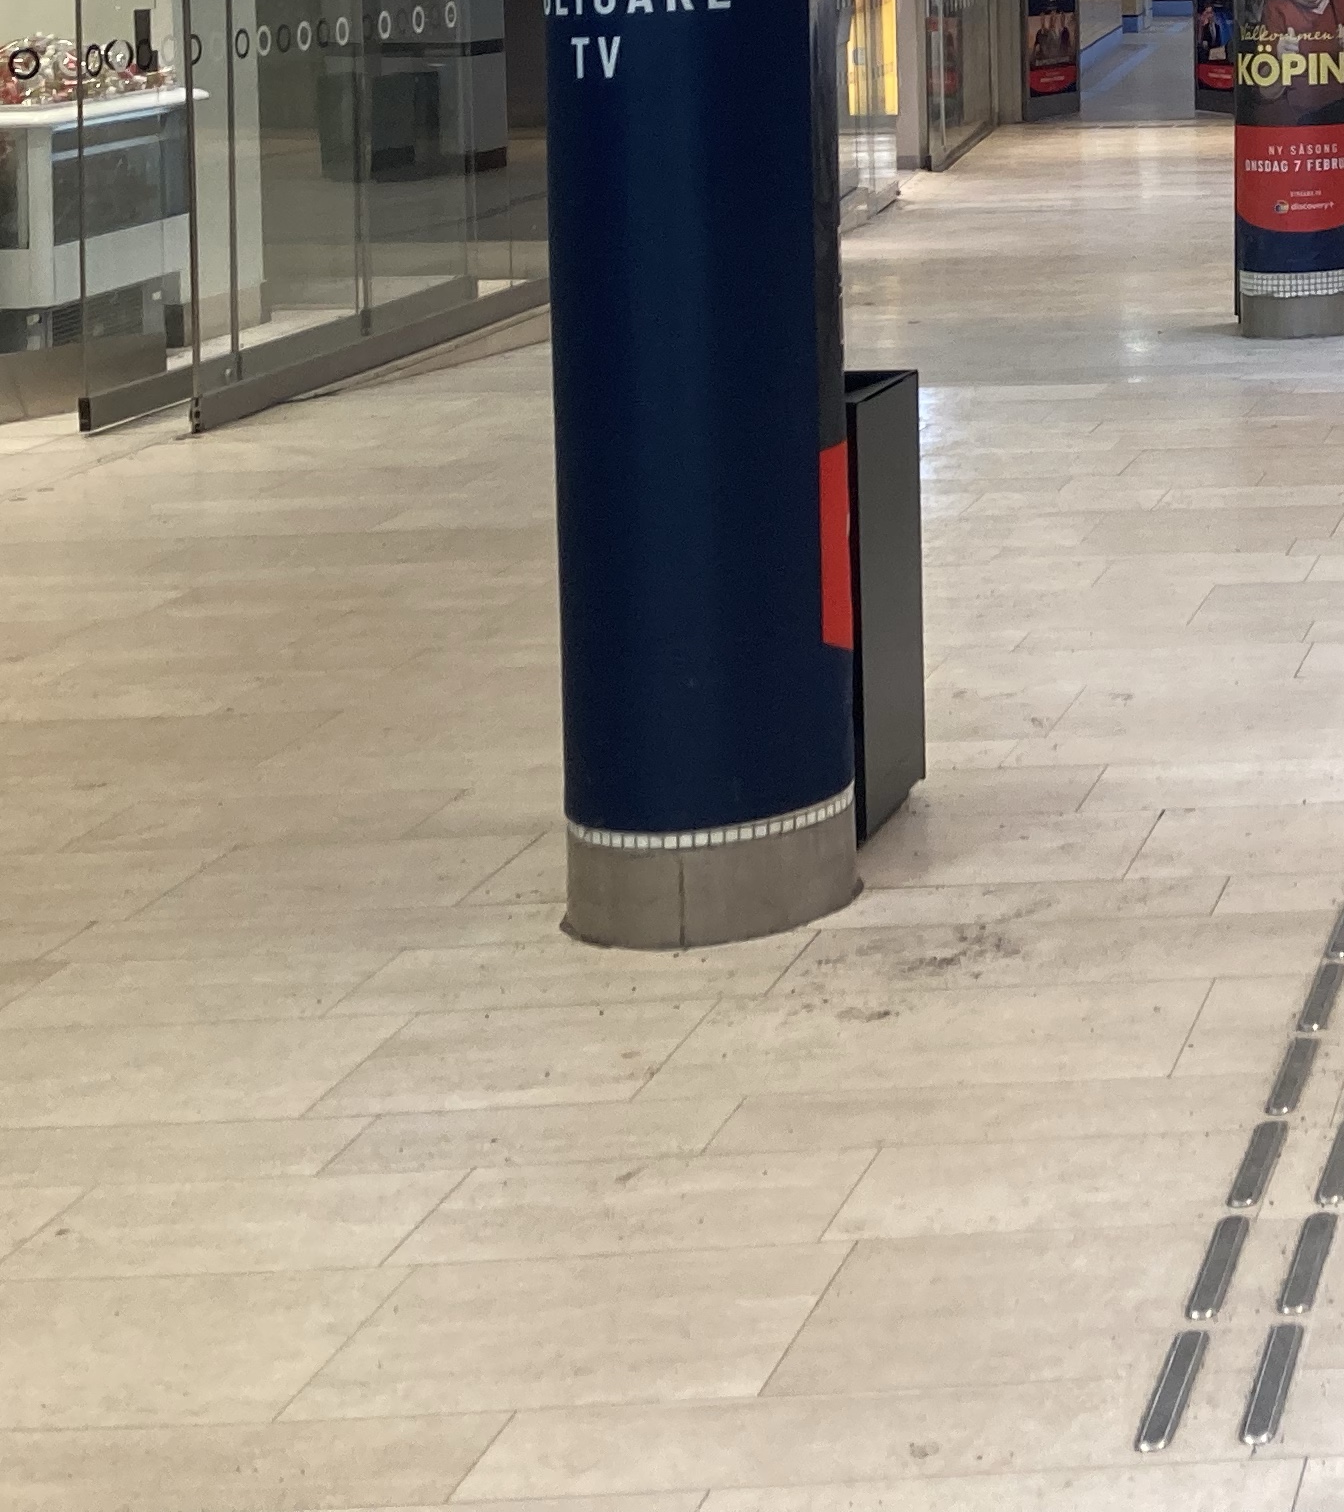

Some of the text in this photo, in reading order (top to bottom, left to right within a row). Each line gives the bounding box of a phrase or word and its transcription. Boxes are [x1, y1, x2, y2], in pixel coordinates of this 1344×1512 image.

[570, 35, 622, 80] TV
[1268, 145, 1283, 156] NY
[1244, 159, 1289, 173] ONSDAG
[1293, 160, 1302, 173] 7
